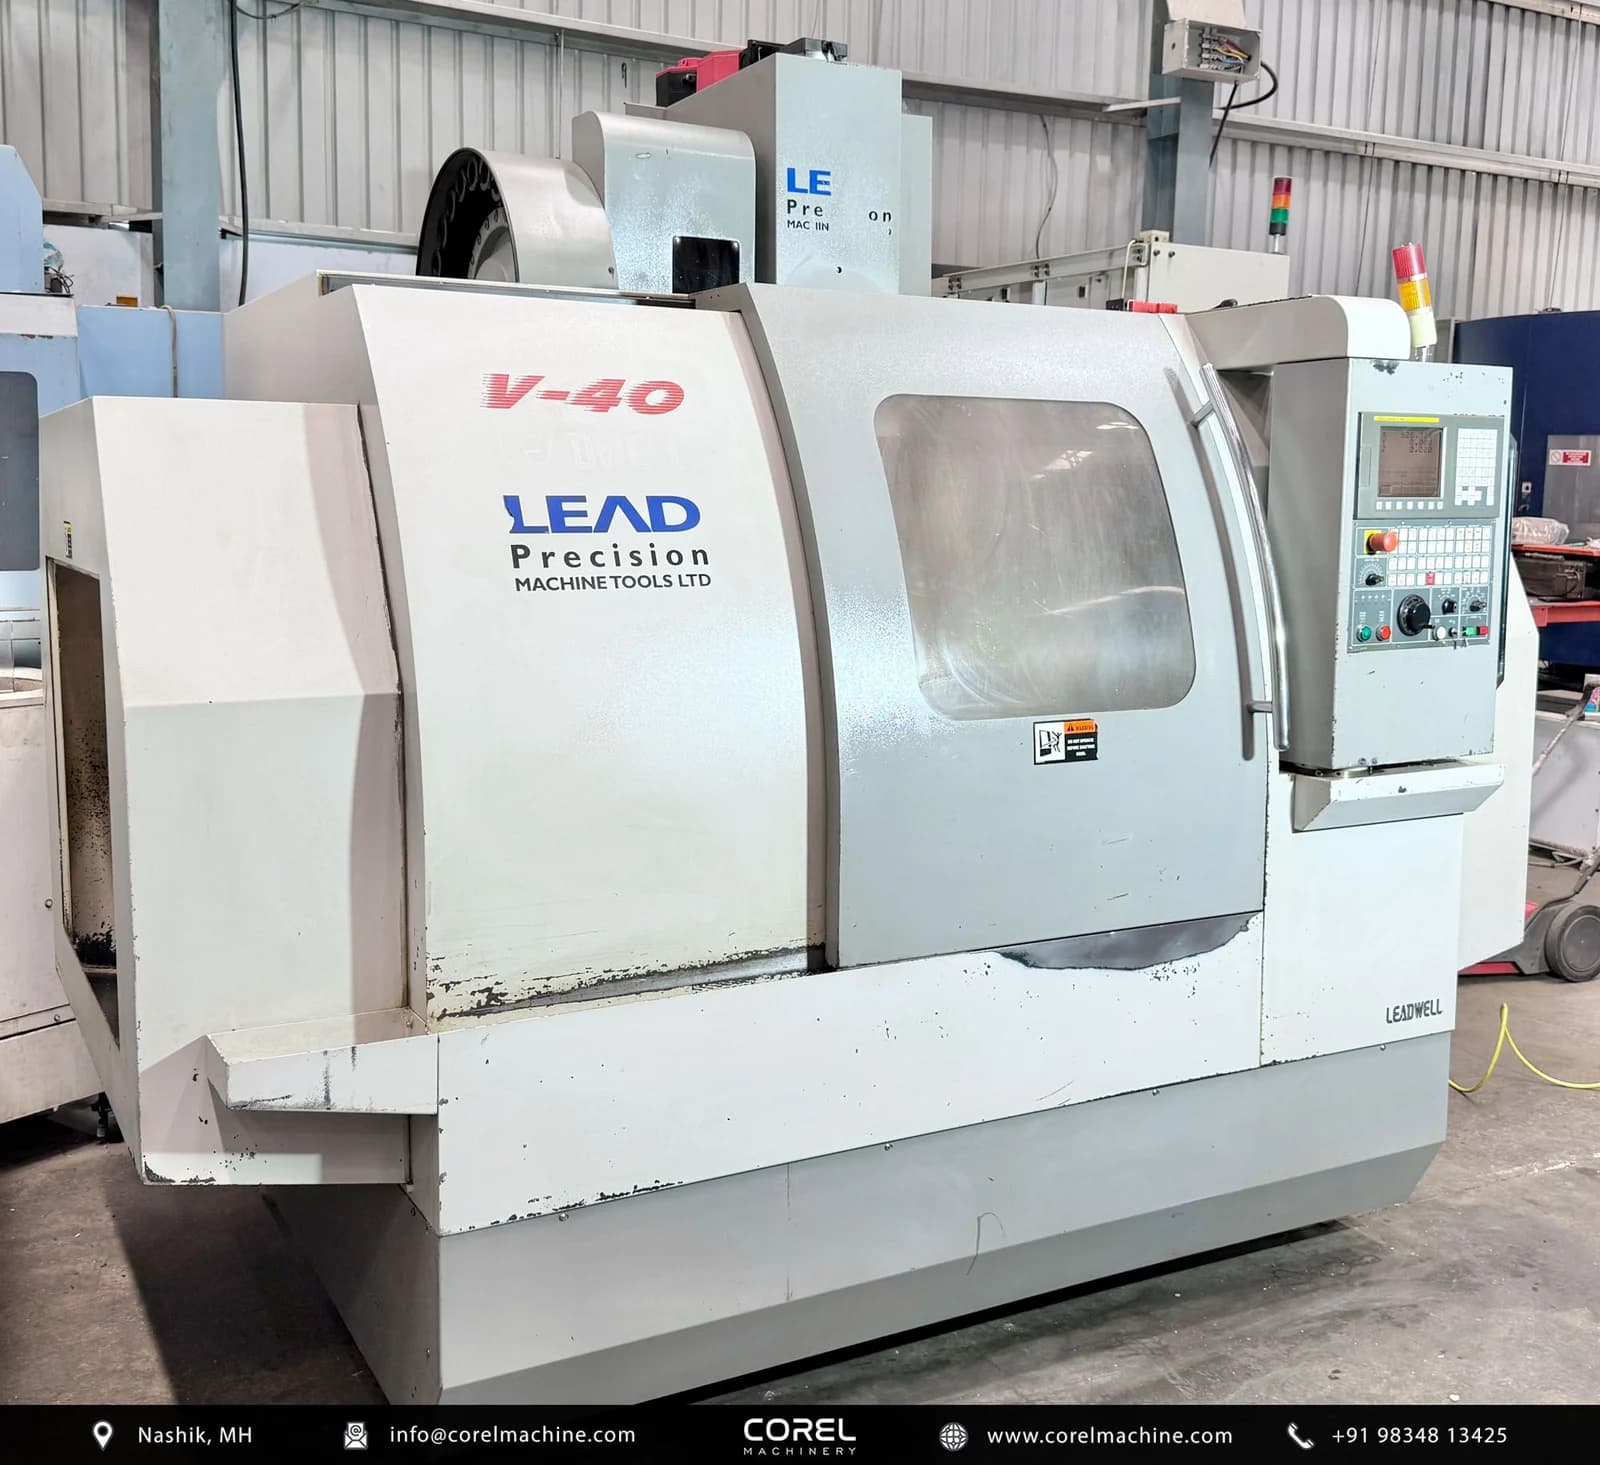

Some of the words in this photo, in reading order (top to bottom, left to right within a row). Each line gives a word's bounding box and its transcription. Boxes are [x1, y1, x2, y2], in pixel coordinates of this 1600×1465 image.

[480, 373, 685, 415] V-40
[503, 495, 701, 534] LEAD
[511, 542, 709, 569] Precision
[515, 576, 608, 592] MACHINE
[608, 574, 673, 589] TOOLS
[677, 573, 712, 588] LTD
[1386, 998, 1443, 1024] LEADWELL
